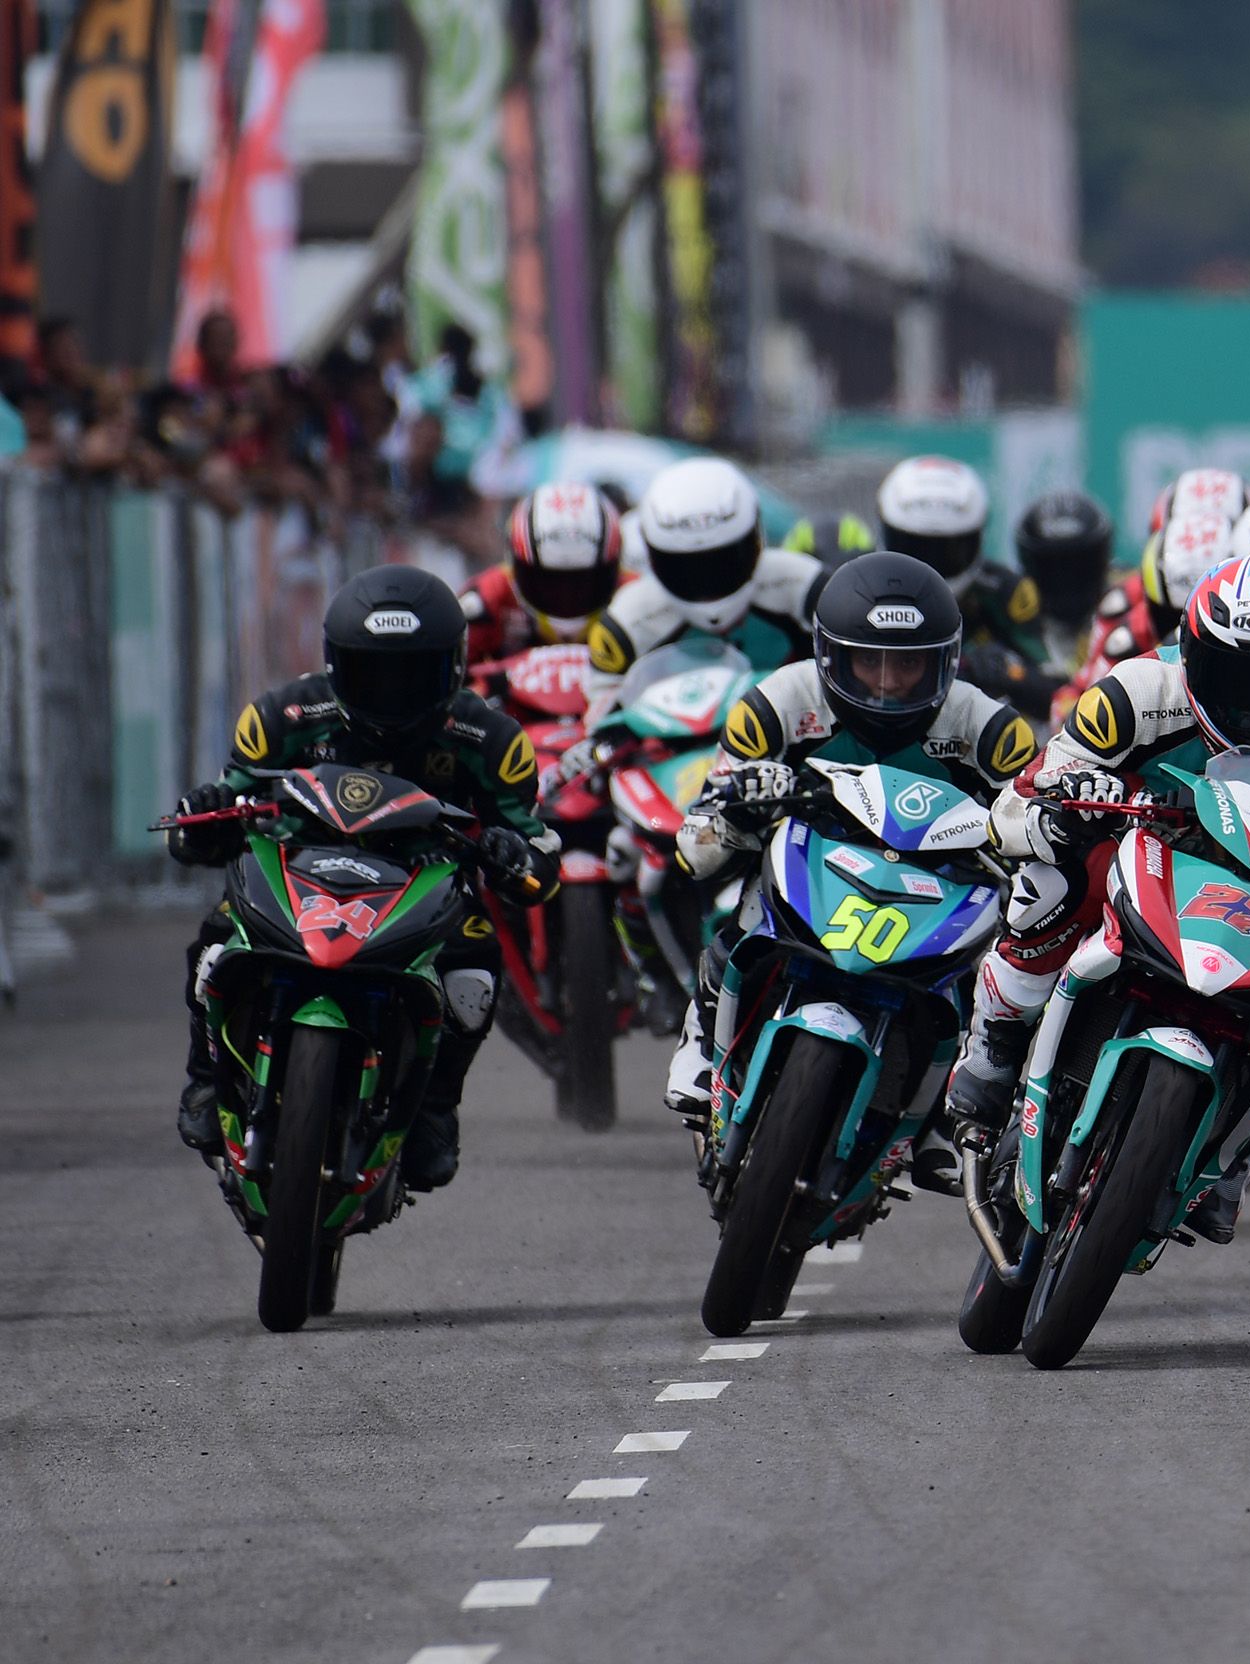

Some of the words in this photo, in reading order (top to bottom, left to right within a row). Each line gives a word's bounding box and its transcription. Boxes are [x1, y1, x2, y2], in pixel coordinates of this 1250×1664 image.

[374, 616, 412, 628] SHOEI
[876, 611, 916, 623] SHOEI
[1142, 707, 1192, 719] PETONAS
[929, 740, 964, 756] SHOE
[851, 778, 880, 826] PETRONAS
[929, 819, 984, 844] PETRONAS
[297, 895, 378, 940] 24
[820, 895, 910, 965] 50
[1034, 903, 1066, 931] TAICHI
[1010, 922, 1080, 959] TAICHI
